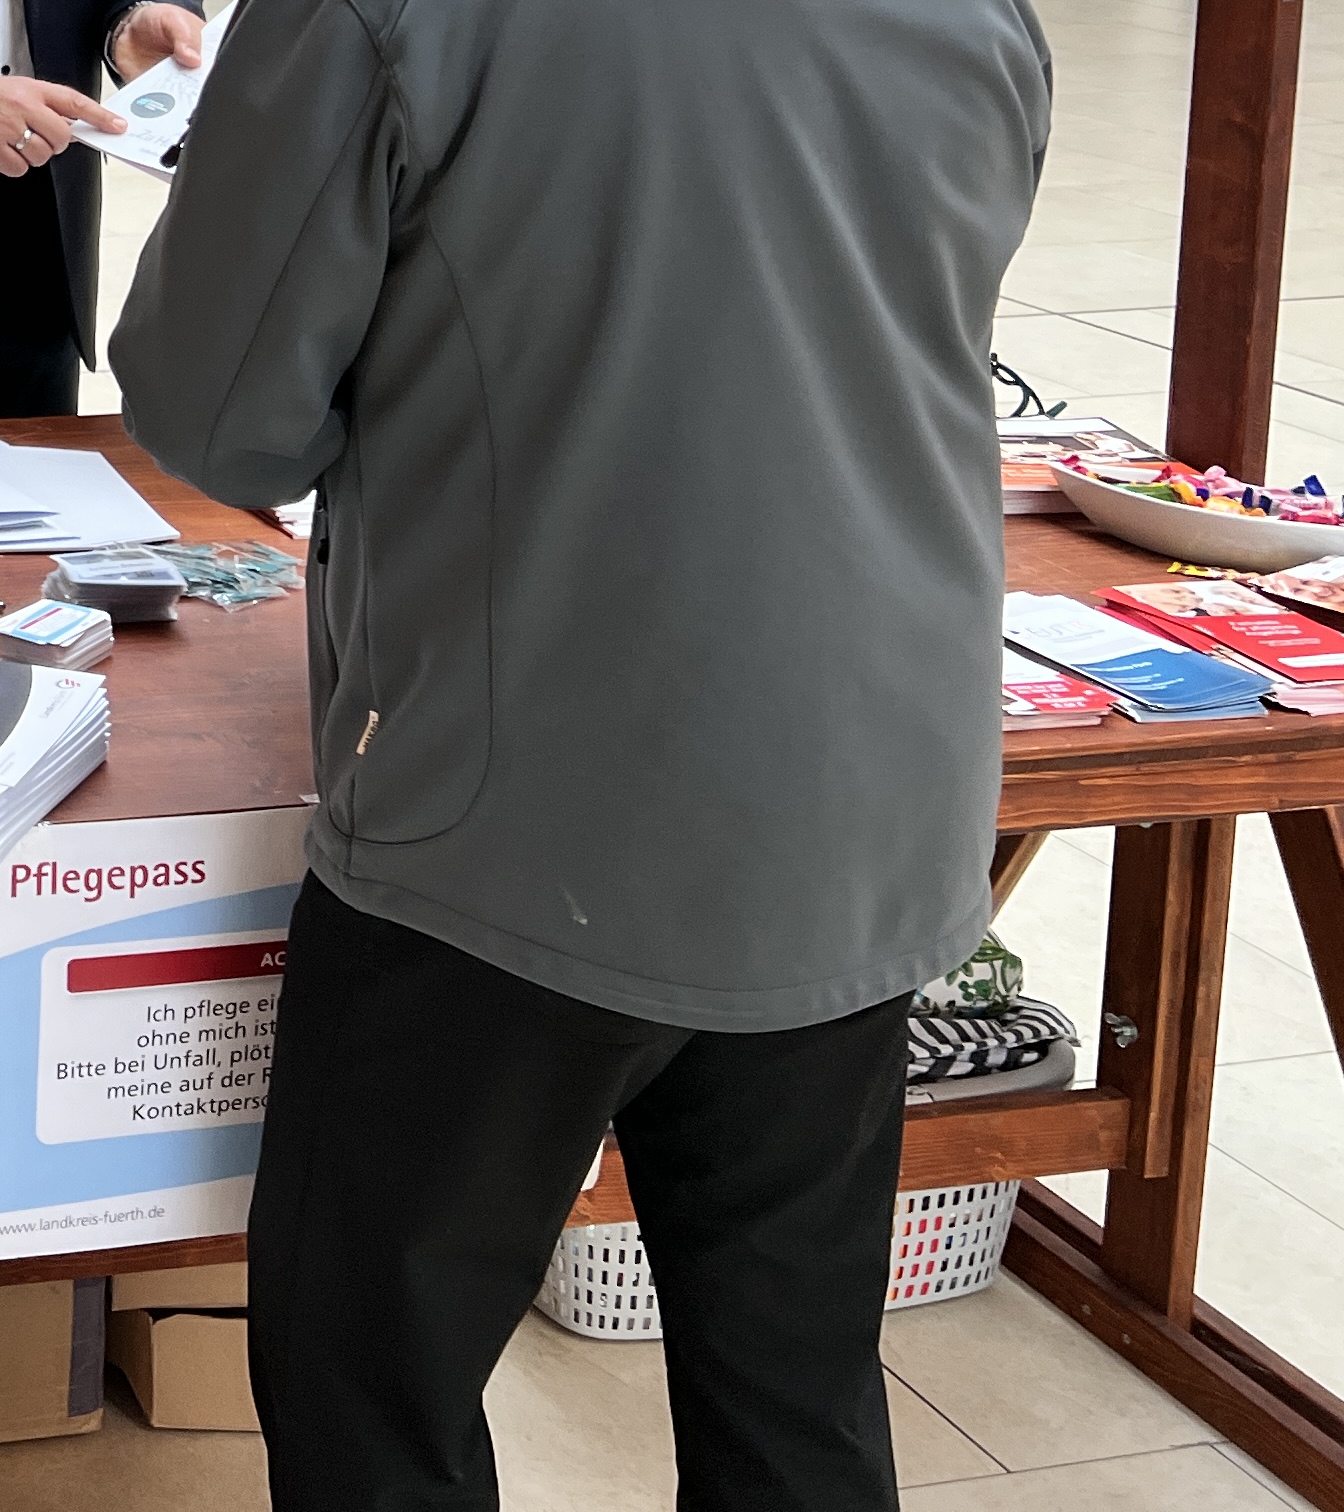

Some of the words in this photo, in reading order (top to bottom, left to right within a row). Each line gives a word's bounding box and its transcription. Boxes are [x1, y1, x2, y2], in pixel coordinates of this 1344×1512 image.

[9, 858, 208, 903] Pflegepass
[260, 951, 287, 968] AC
[146, 1003, 176, 1024] Ich
[183, 998, 251, 1024] pflege
[257, 993, 278, 1013] ei
[136, 1029, 191, 1048] ohne
[198, 1020, 247, 1043] mich
[56, 1057, 107, 1081] Bitte
[114, 1054, 146, 1075] bei
[153, 1047, 222, 1071] Unfall,
[230, 1043, 273, 1069] plöt
[107, 1078, 173, 1100] meine
[179, 1072, 215, 1093] auf
[220, 1069, 256, 1089] der
